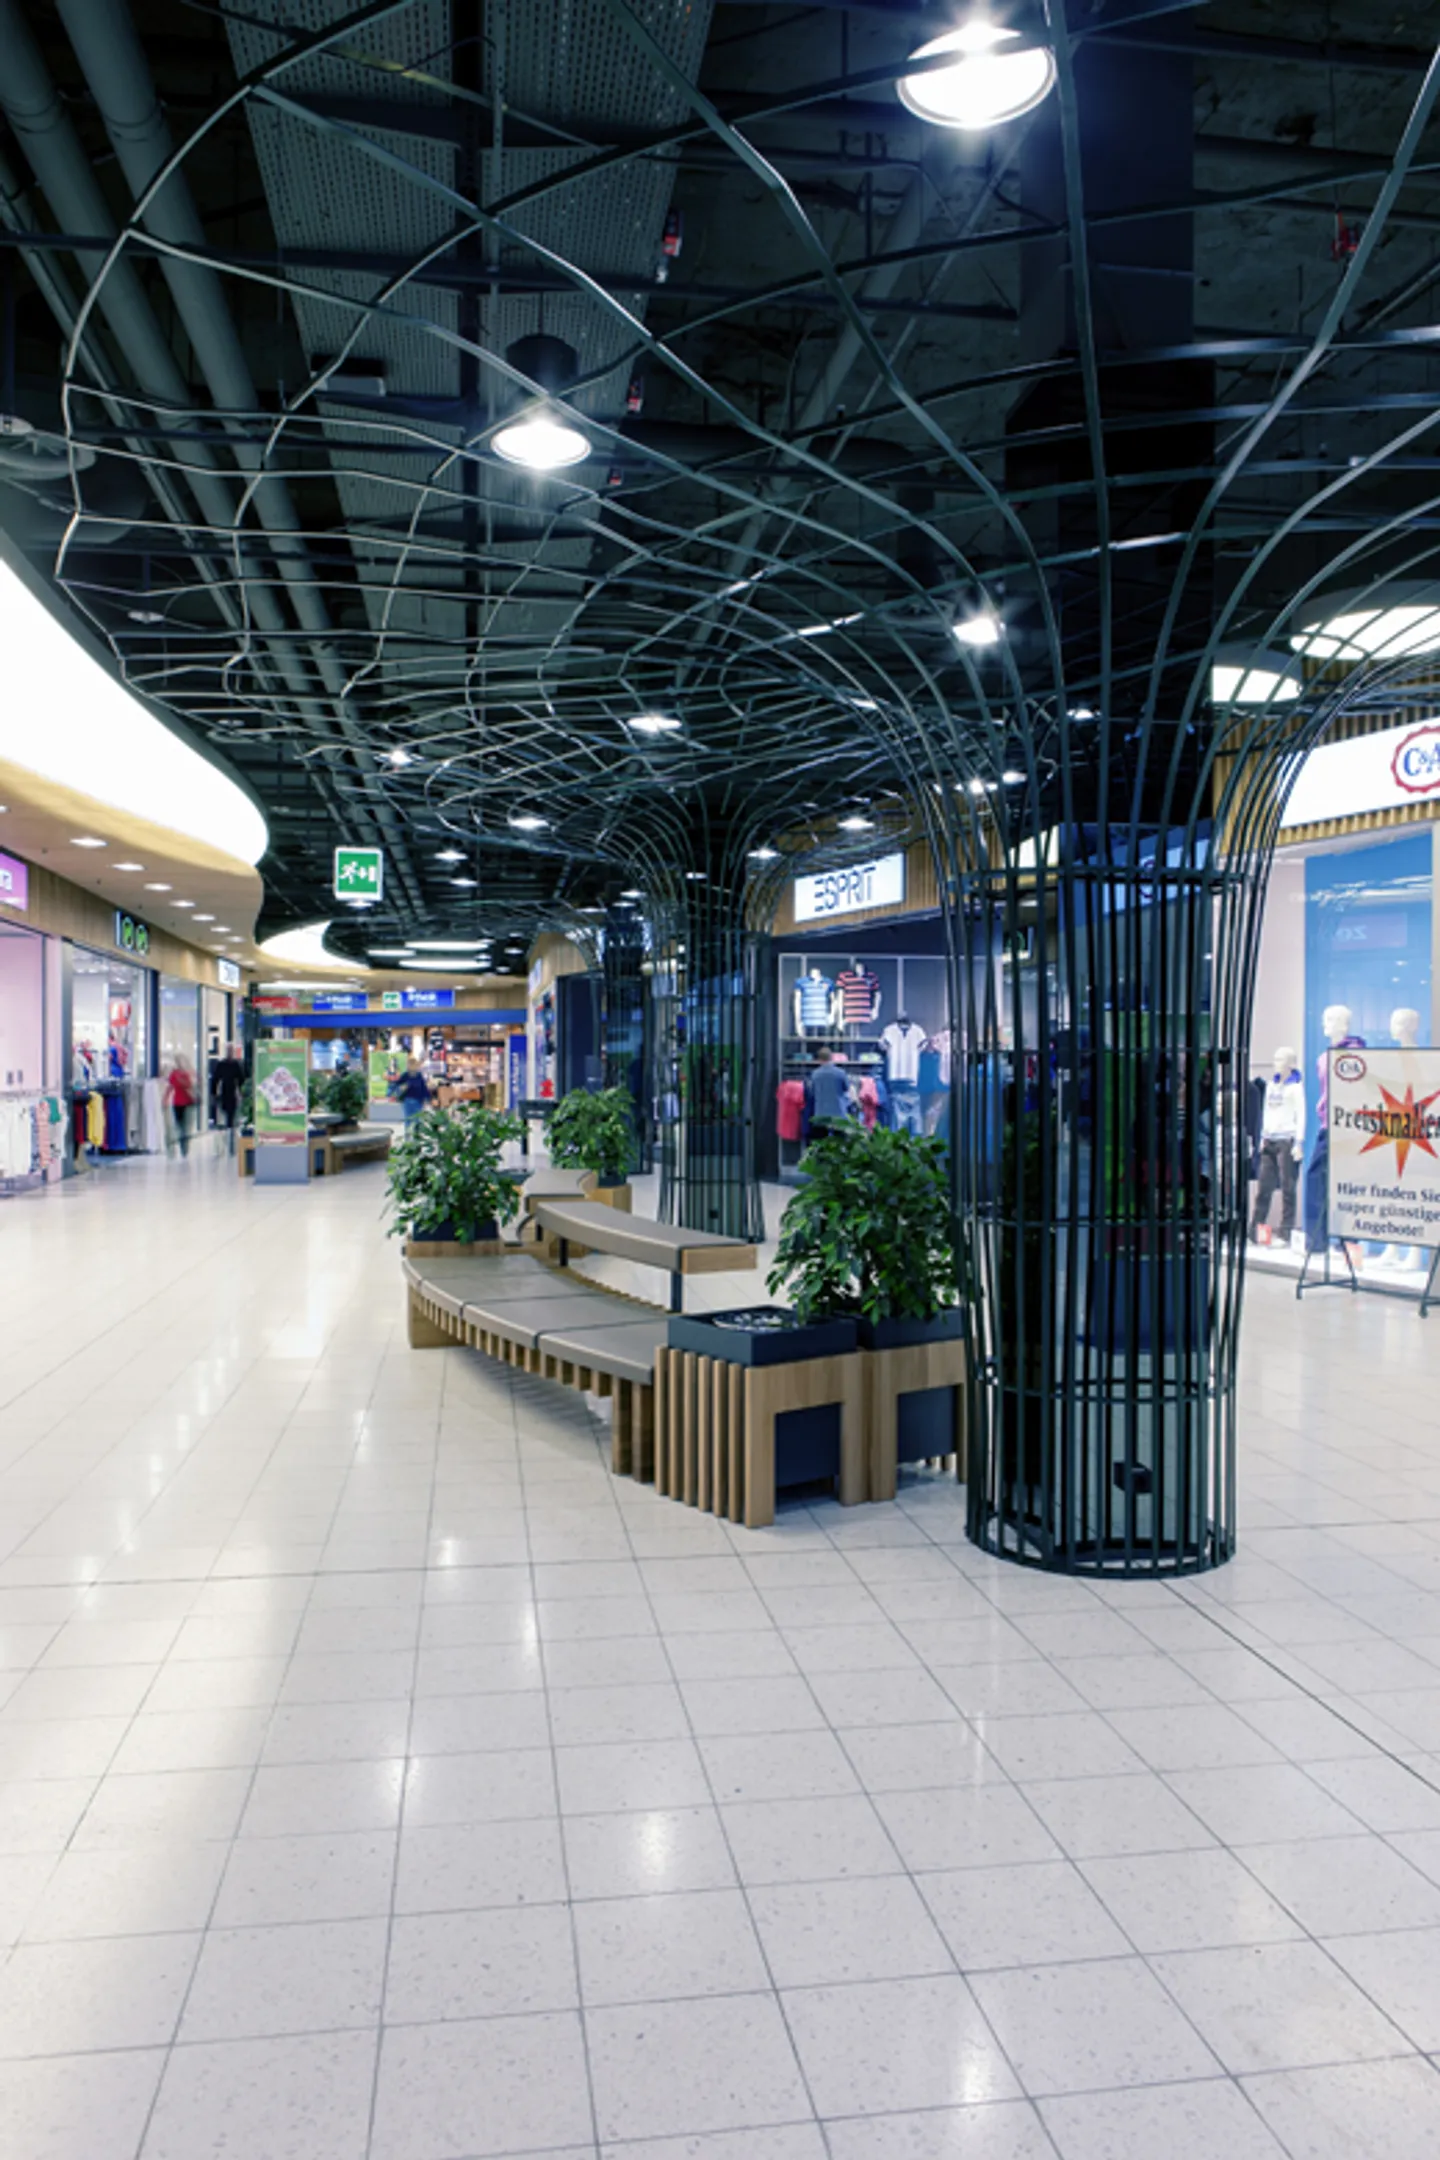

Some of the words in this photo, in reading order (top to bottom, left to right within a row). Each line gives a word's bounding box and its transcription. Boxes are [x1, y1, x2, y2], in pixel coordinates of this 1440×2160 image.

[814, 866, 876, 912] ESPRIT
[1337, 1182, 1367, 1196] Hier
[1370, 1183, 1417, 1201] finden
[1337, 1201, 1375, 1217] super
